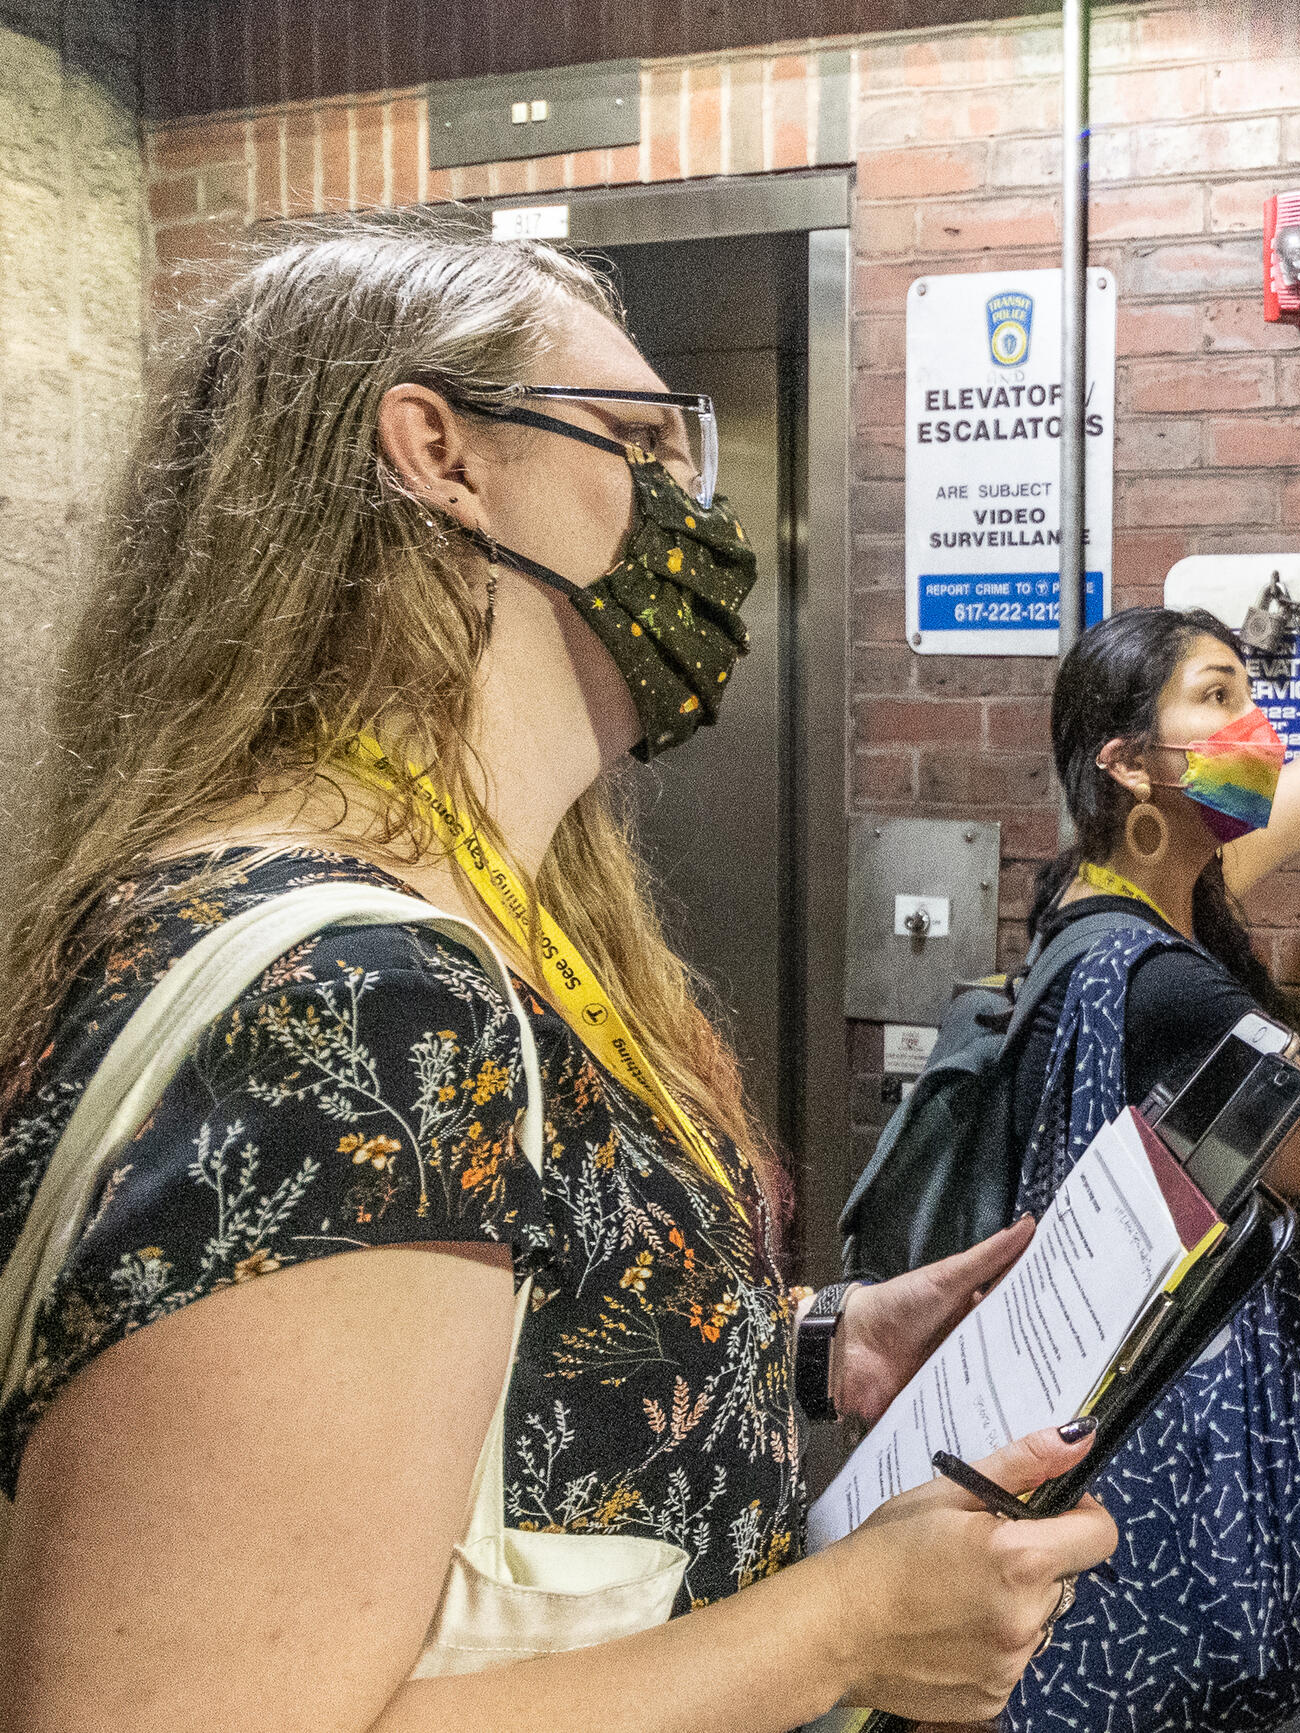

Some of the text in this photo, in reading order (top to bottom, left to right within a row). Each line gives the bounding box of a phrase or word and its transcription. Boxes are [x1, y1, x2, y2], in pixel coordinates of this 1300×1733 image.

[988, 296, 1031, 311] TRANSIT
[993, 309, 1027, 322] POLICE
[917, 414, 1104, 443] ESCALATOS
[936, 482, 1052, 500] ARE SUBJECT
[973, 508, 1046, 525] VIDEO
[929, 529, 1091, 548] SURVEILLANE
[926, 583, 970, 596] REPORT
[975, 582, 1011, 595] CRIME
[1016, 582, 1032, 595] TO
[463, 835, 486, 871] Say
[493, 869, 559, 960] Soething,
[555, 958, 582, 991] See
